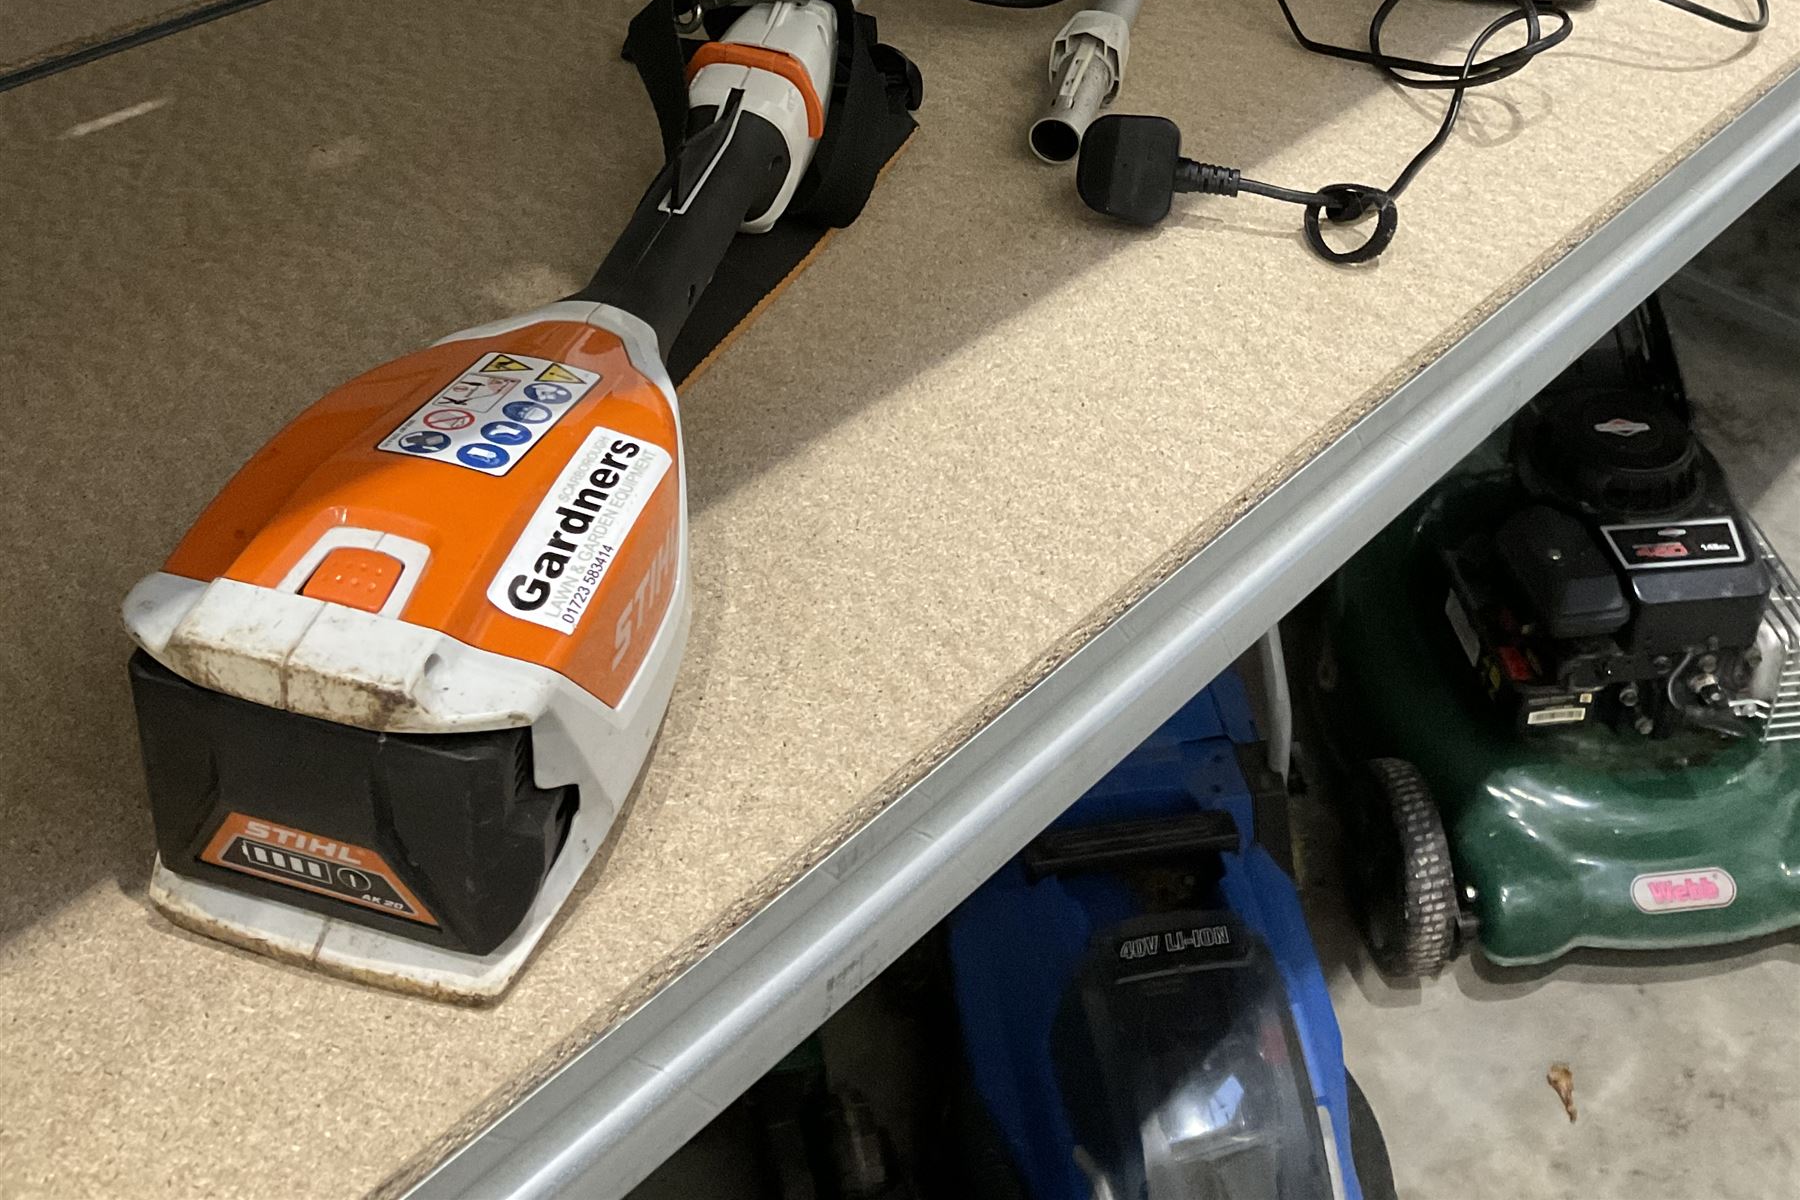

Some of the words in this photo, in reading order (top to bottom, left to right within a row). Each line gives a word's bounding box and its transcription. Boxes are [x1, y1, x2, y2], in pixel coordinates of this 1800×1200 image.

[557, 435, 609, 503] SCARBOROUGH
[610, 448, 658, 508] EQUIPMENT
[507, 439, 640, 611] Gardners
[577, 508, 620, 563] GARDEN
[562, 584, 591, 624] 01723
[582, 543, 614, 586] 583414
[574, 563, 586, 576] &
[544, 574, 580, 618] LAWN
[244, 820, 362, 866] STIHL
[361, 894, 382, 905] AK
[384, 900, 404, 911] 20
[1648, 877, 1719, 905] Webb
[1119, 935, 1160, 960] 40V
[1164, 925, 1230, 952] LI-ION
